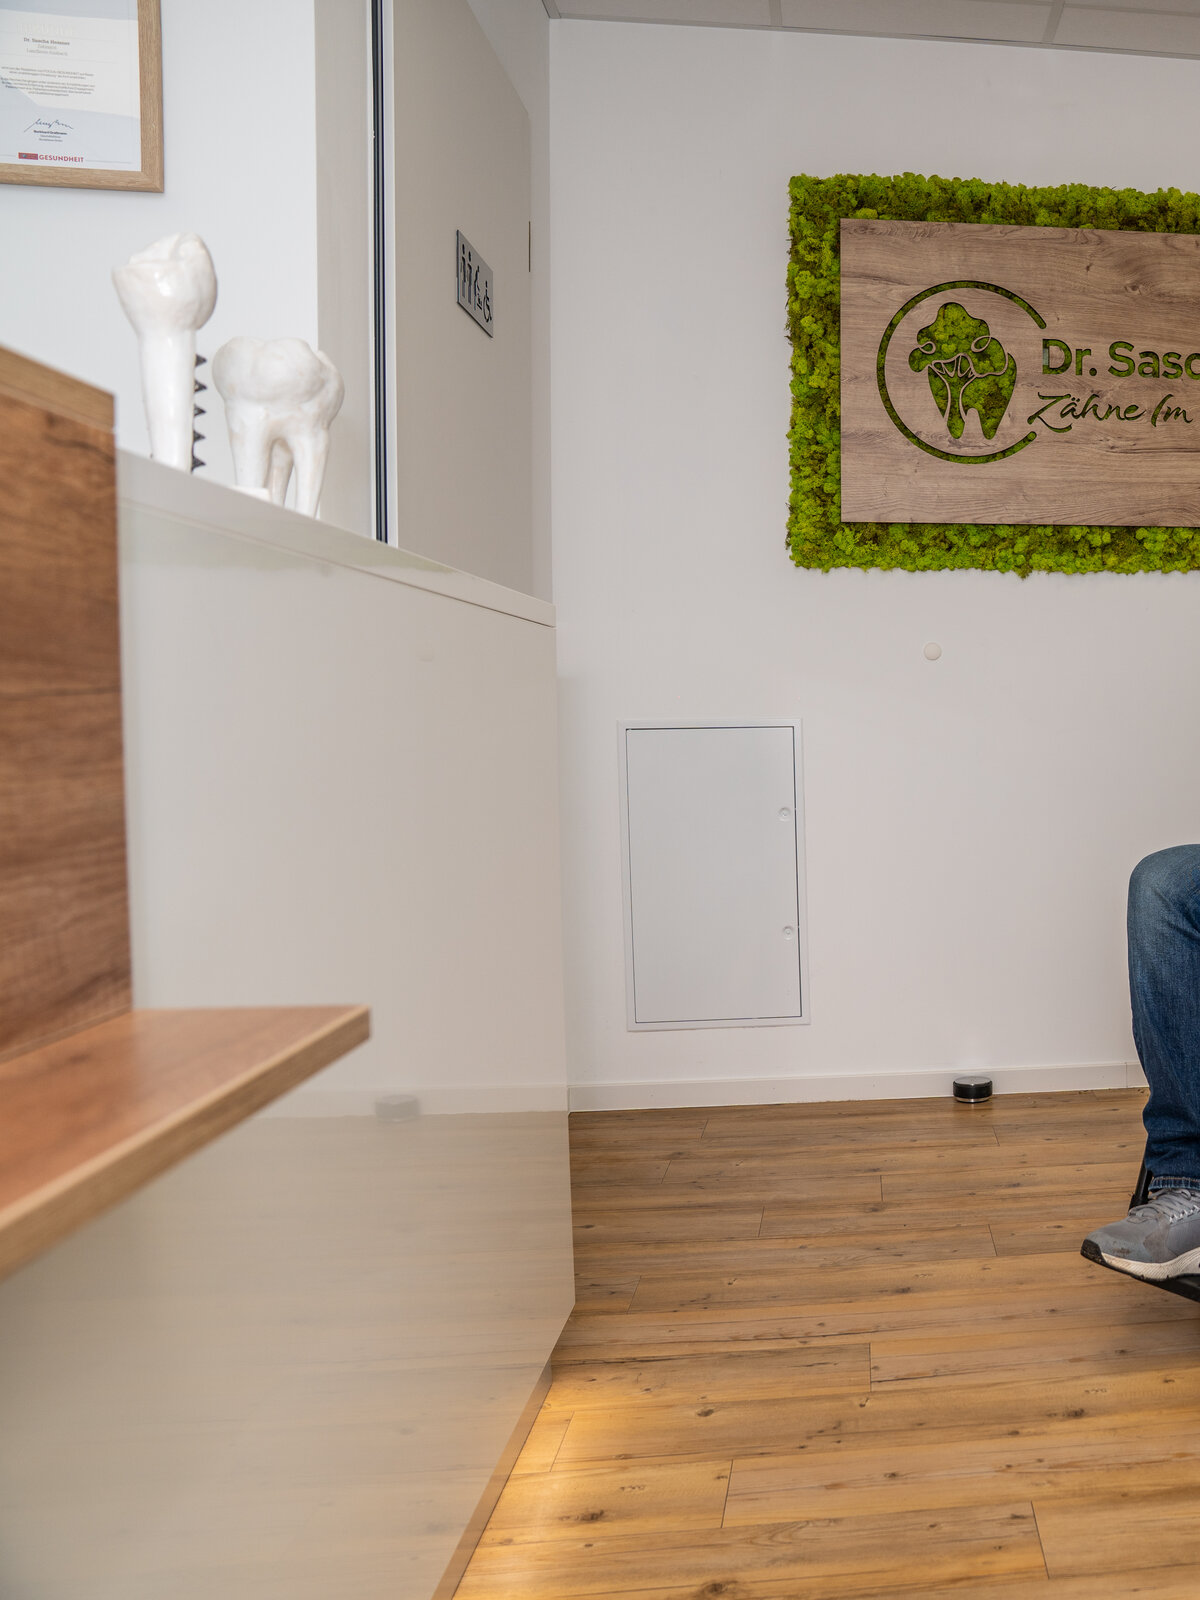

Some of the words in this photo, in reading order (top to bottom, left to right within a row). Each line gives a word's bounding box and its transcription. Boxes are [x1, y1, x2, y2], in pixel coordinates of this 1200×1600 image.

[38, 154, 84, 163] GESUNDHEIT
[1042, 338, 1098, 377] Dr.
[1027, 391, 1147, 433] Zähne
[1151, 393, 1194, 427] Im
